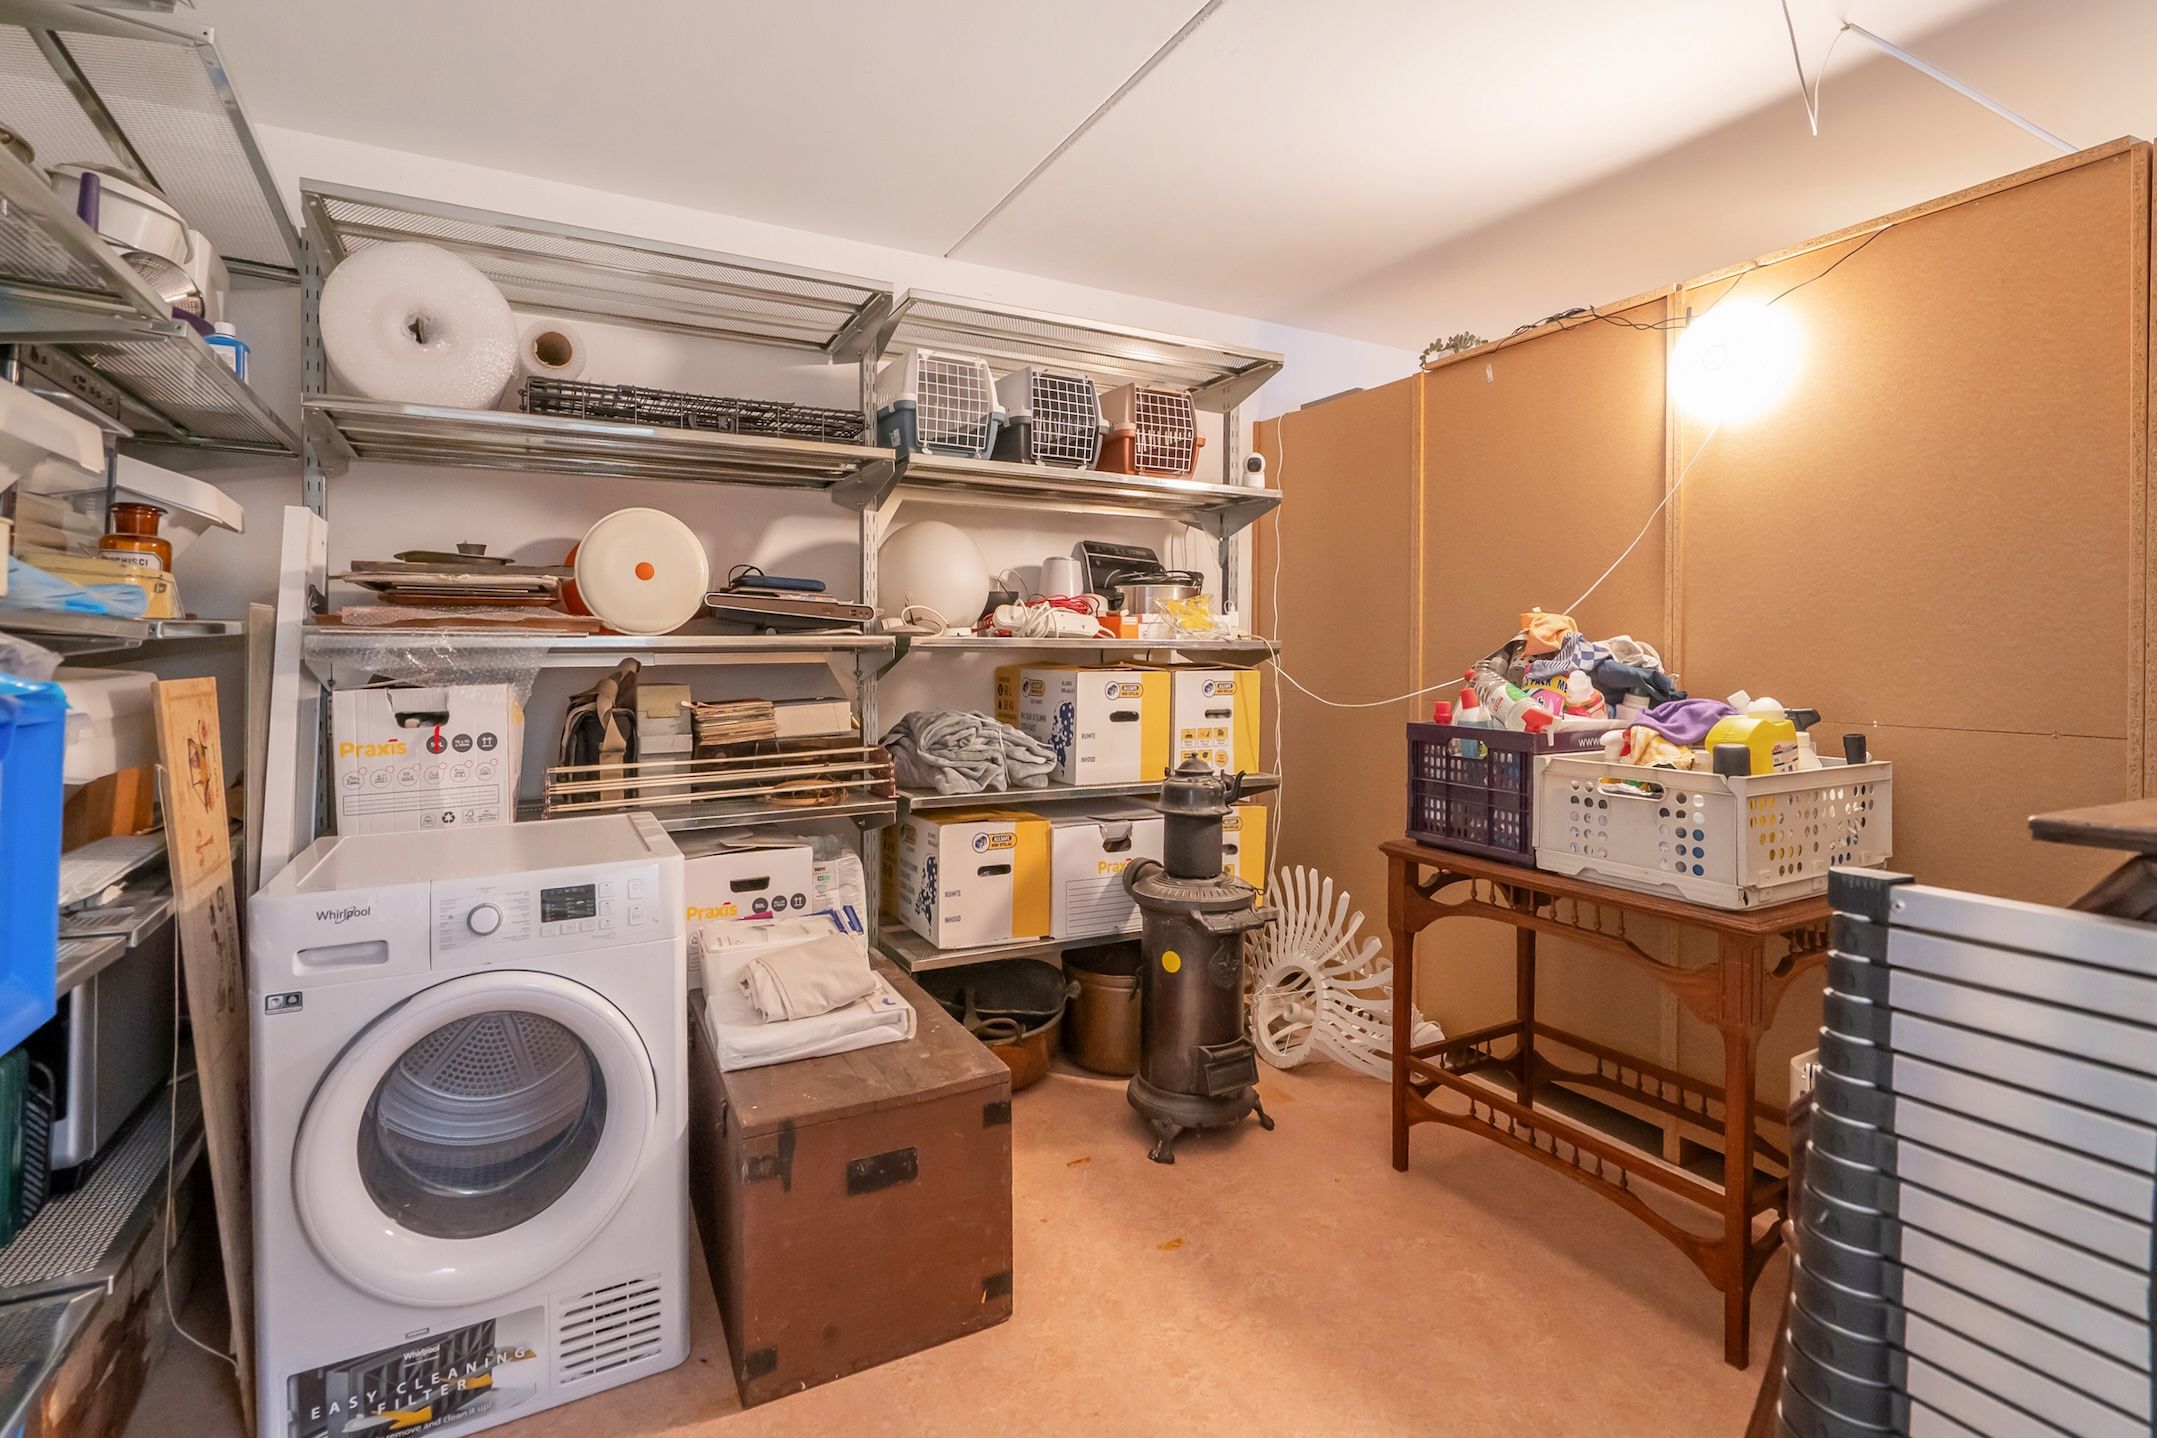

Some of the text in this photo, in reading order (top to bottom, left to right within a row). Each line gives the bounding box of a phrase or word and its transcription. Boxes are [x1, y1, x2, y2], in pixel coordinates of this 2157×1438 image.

[339, 738, 409, 759] Praxis
[1097, 861, 1126, 875] Prax
[944, 890, 961, 898] RUIMTE
[316, 906, 371, 924] Whirlpool
[687, 902, 737, 921] Praxis
[944, 915, 961, 924] INHOUD
[403, 1344, 440, 1362] Whirlpool
[311, 1346, 526, 1420] EASY CLEANING
[377, 1379, 467, 1415] FILTER
[386, 1424, 422, 1438] remove
[423, 1416, 443, 1431] and
[443, 1411, 467, 1424] clean
